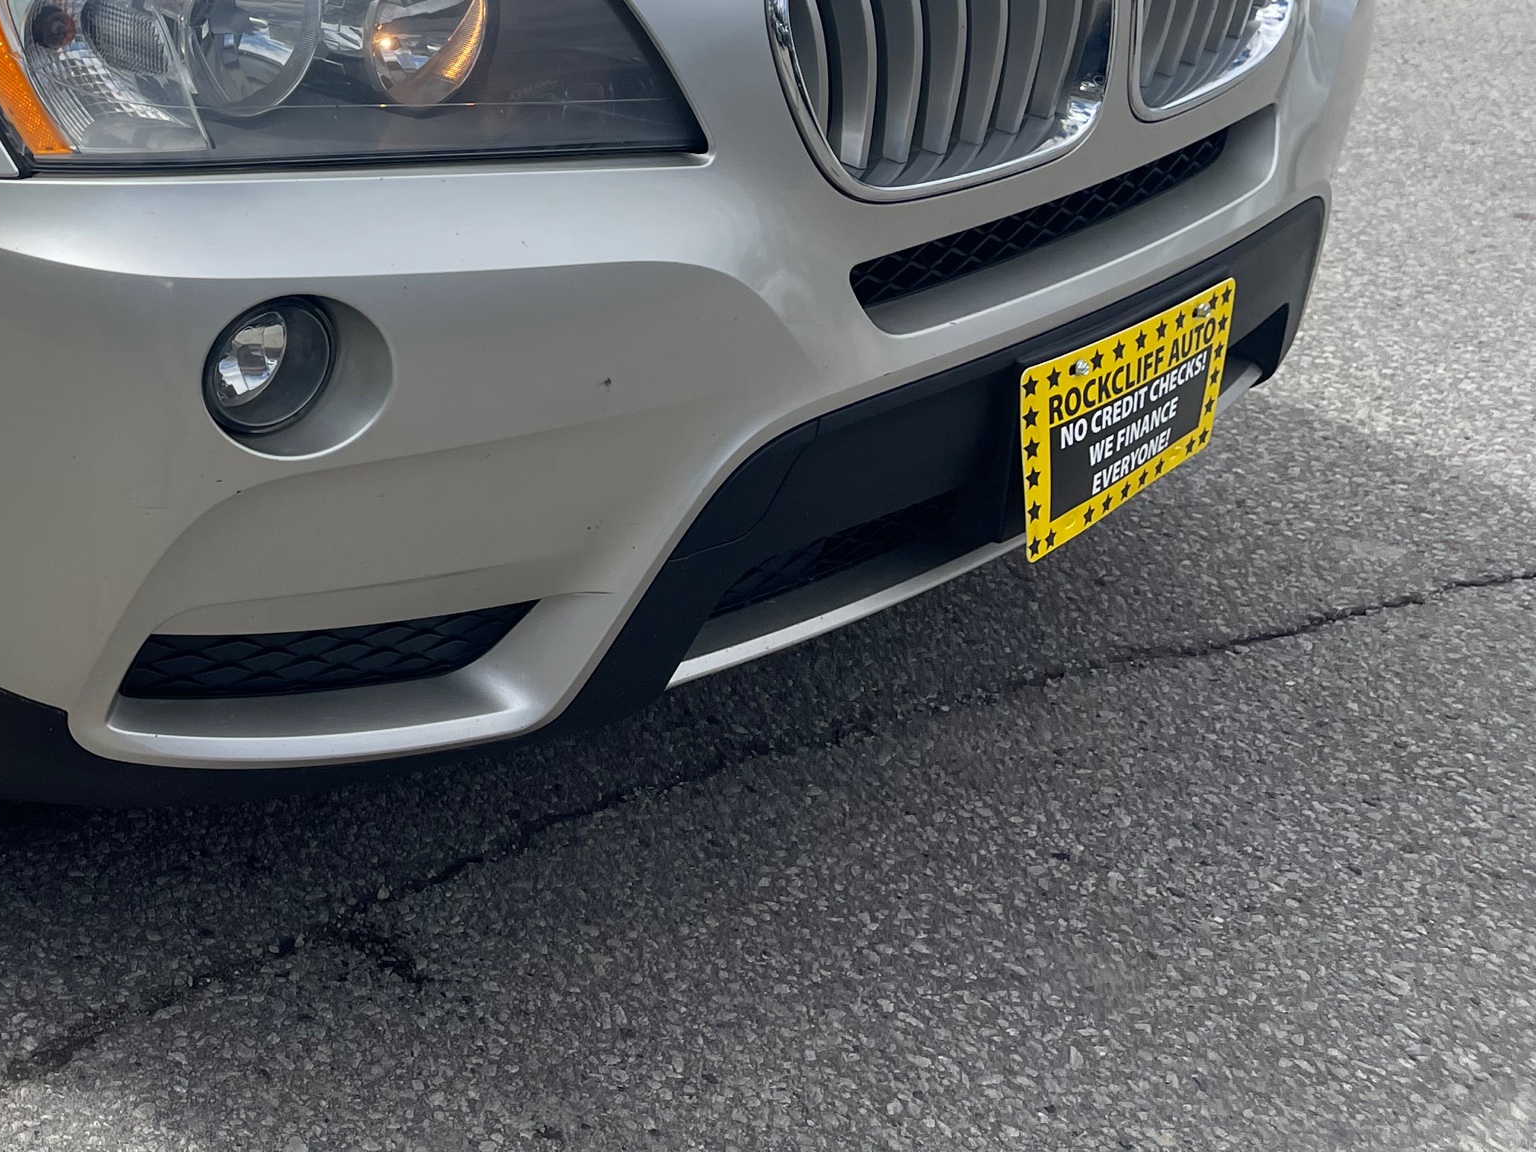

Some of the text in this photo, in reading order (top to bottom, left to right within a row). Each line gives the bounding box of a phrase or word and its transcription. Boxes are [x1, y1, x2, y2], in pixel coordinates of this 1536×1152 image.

[1049, 317, 1216, 425] ROCKCLIFF AUTO
[1060, 351, 1207, 449] NO CREDIT CHECKS!
[1089, 397, 1179, 466] WE FINANCE
[1091, 428, 1172, 495] EVERYONE!
